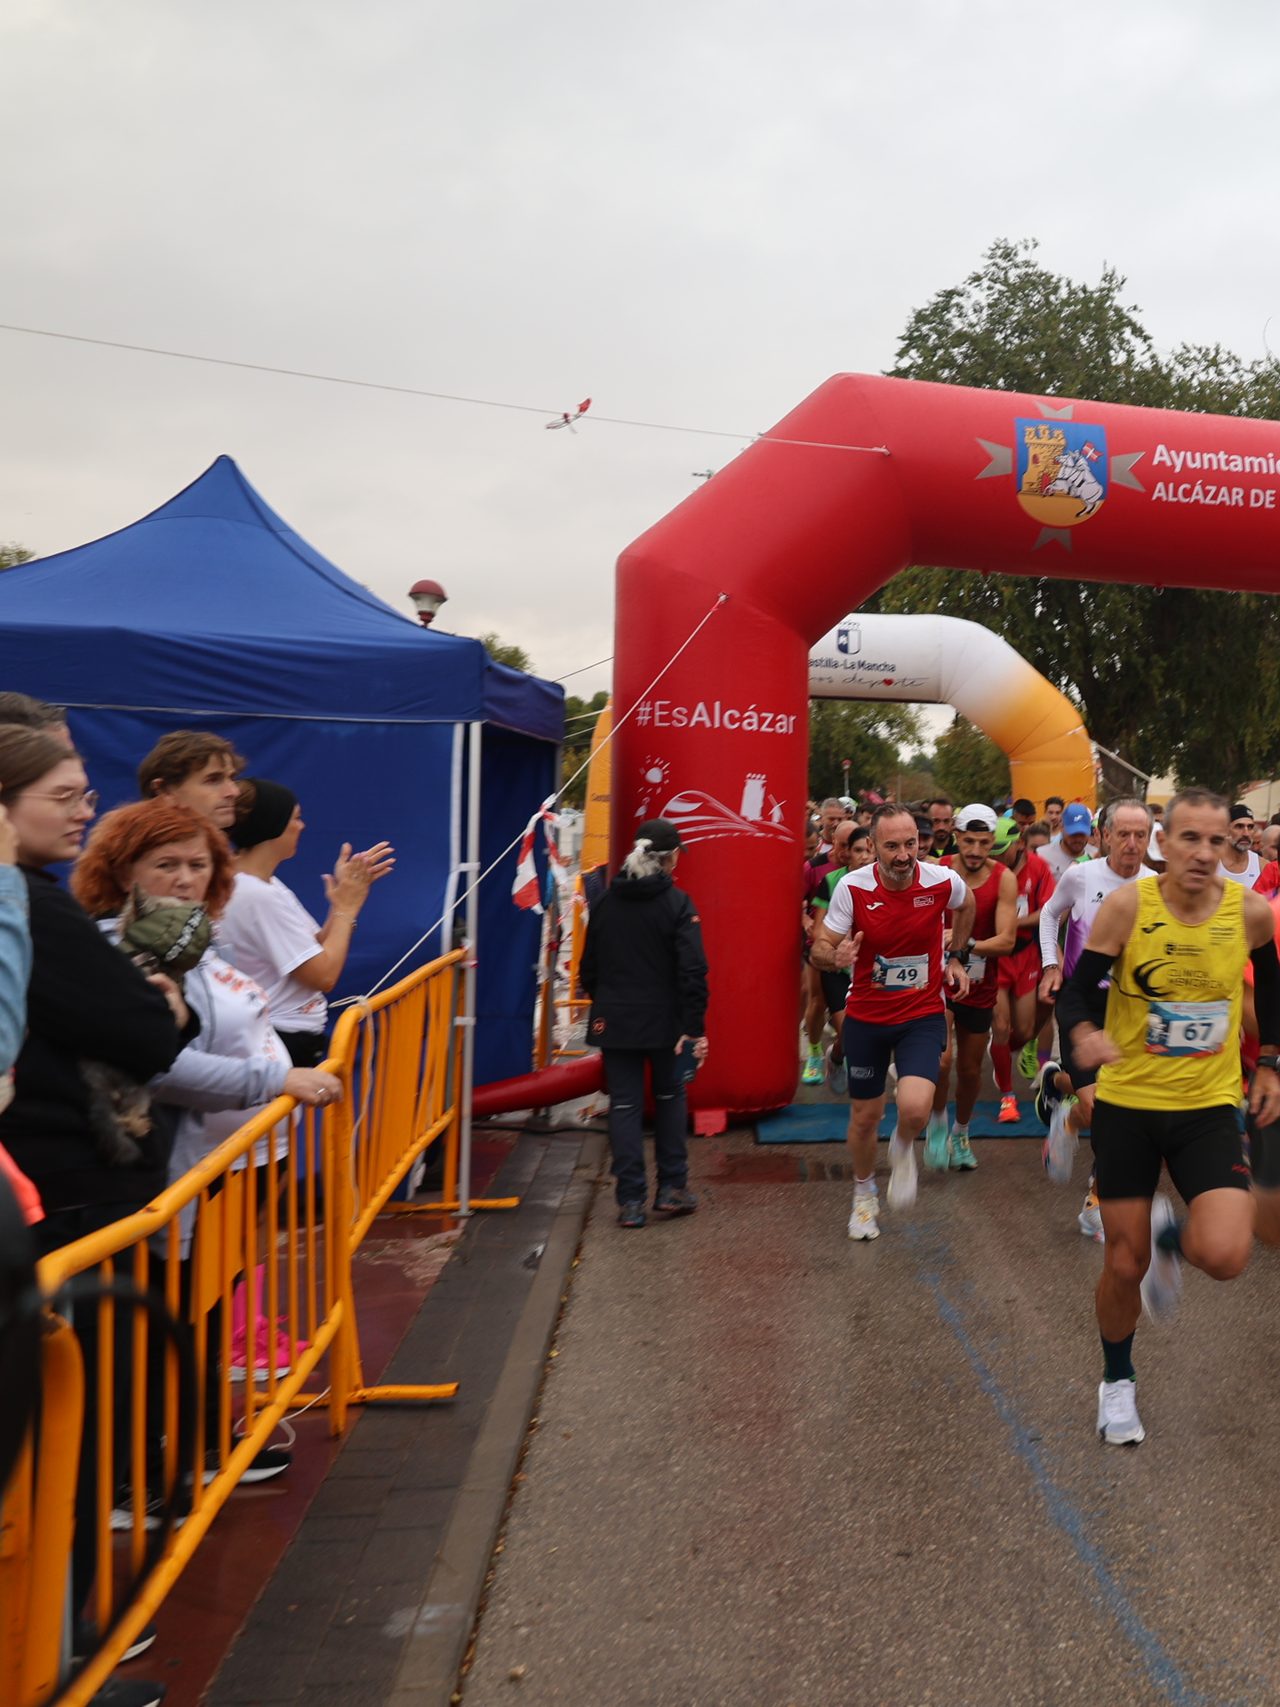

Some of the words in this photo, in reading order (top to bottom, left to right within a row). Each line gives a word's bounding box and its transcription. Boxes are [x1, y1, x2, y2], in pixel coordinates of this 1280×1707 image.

[1151, 479, 1244, 507] ALCÁZAR
[1249, 488, 1276, 510] DE
[807, 656, 855, 671] astilla-La
[635, 700, 797, 735] #EsAlcázar
[896, 968, 918, 982] 49
[1184, 1022, 1213, 1042] 67
